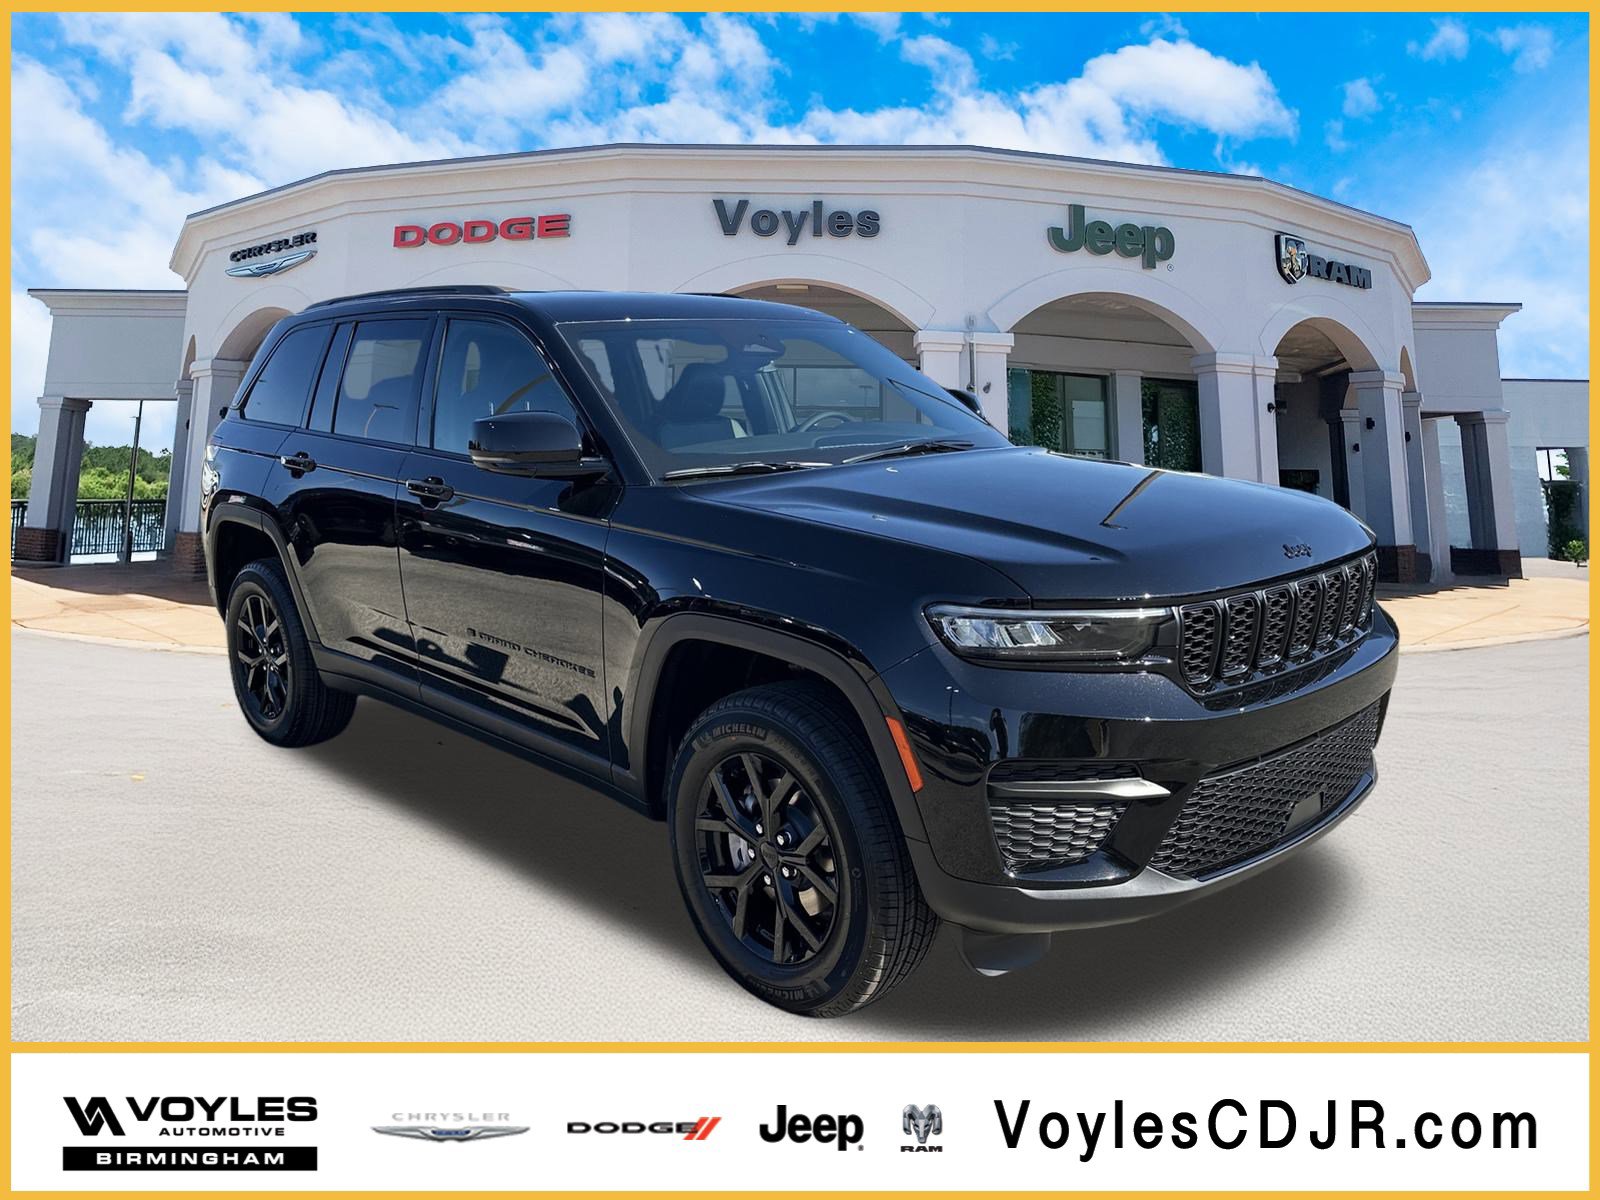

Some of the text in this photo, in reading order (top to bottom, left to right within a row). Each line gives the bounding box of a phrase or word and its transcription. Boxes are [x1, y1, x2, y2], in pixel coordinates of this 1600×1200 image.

[393, 214, 571, 249] DODGE
[712, 199, 880, 245] Voyles
[1047, 204, 1175, 270] Jeep
[229, 231, 318, 262] CHRYSLER
[1307, 254, 1372, 289] RAM
[711, 723, 767, 740] MICHELIN
